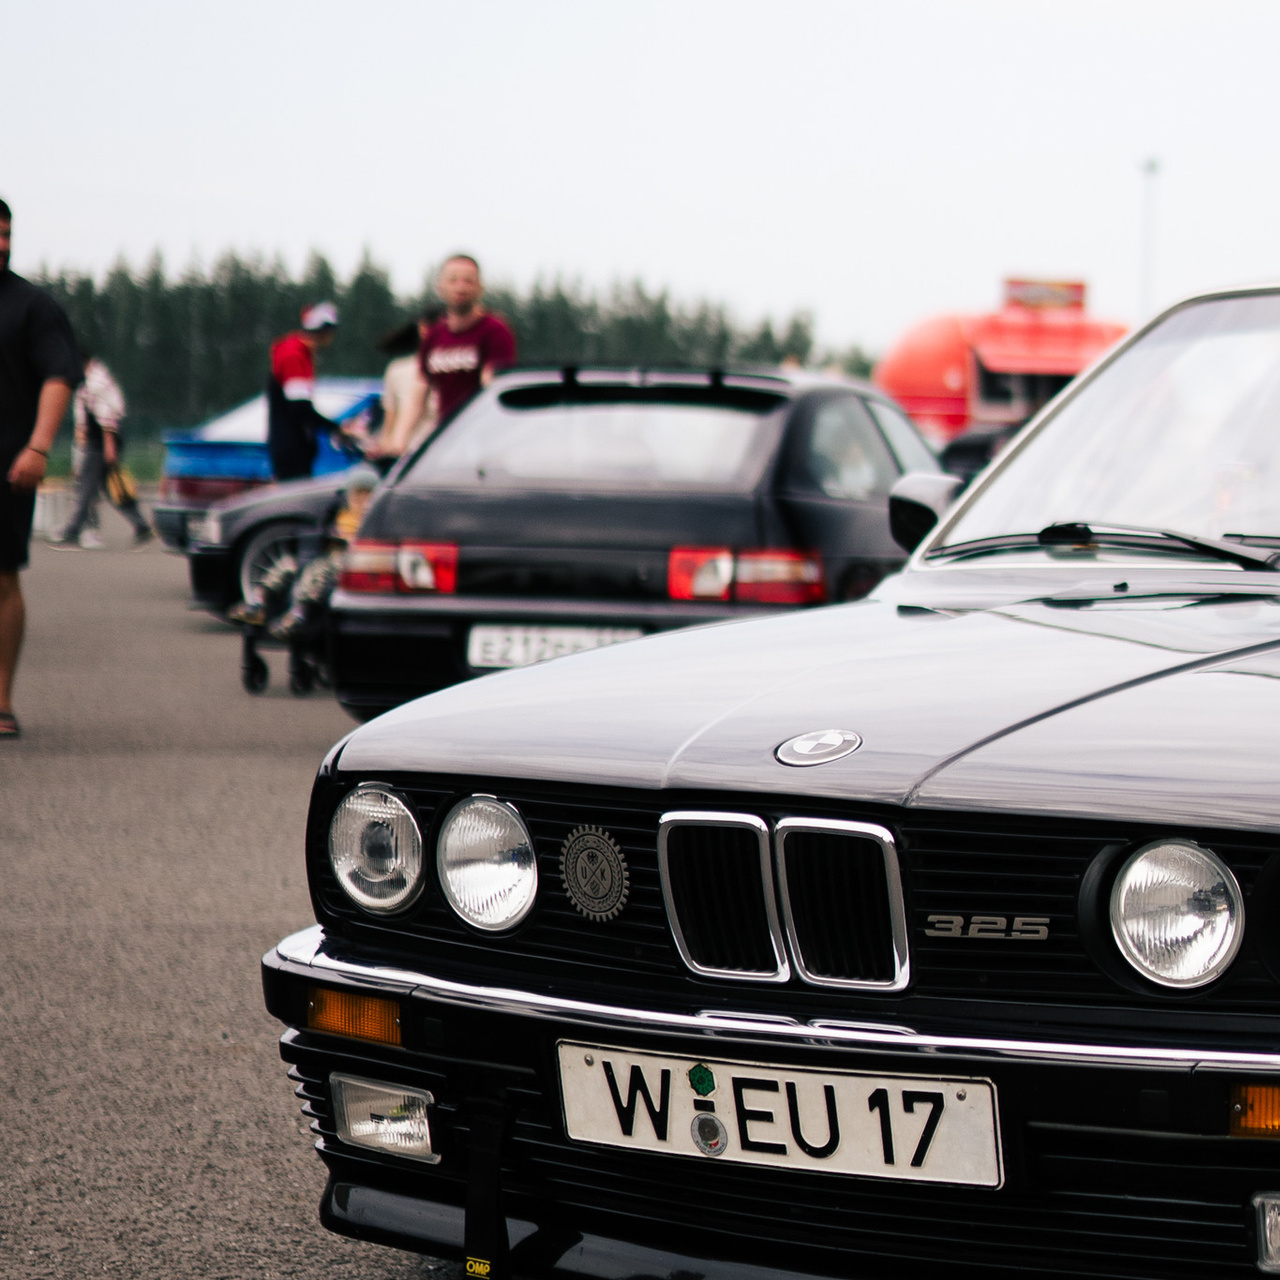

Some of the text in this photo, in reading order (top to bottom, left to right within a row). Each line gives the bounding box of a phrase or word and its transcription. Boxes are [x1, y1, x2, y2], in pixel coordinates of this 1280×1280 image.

[924, 915, 1050, 940] 325
[868, 1088, 945, 1168] 17
[466, 1260, 490, 1275] OMP
